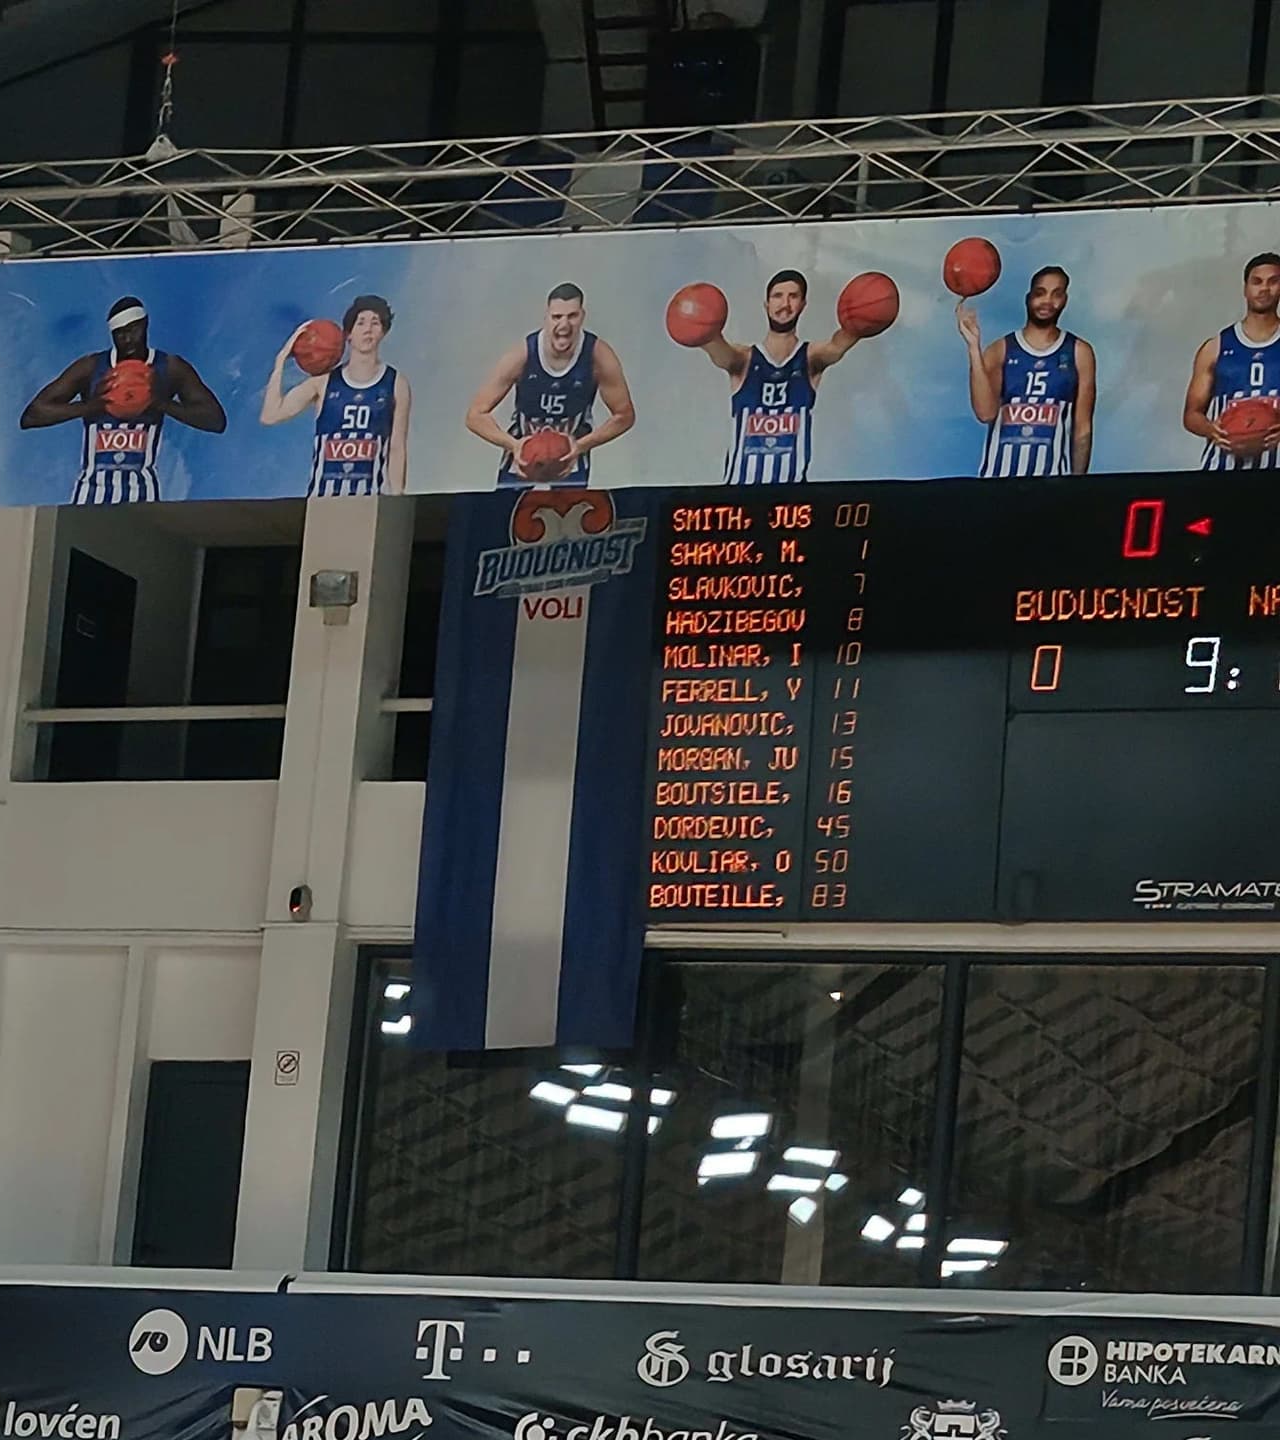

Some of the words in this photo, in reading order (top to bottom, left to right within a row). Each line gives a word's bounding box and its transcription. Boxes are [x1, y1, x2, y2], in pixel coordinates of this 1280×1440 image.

[1025, 370, 1050, 396] 15
[1250, 362, 1265, 387] 0
[539, 393, 566, 415] 45
[761, 382, 788, 406] 83
[341, 404, 370, 430] 50
[753, 414, 796, 435] VOLI
[1007, 405, 1056, 425] VOLI
[100, 430, 147, 450] VOLI
[328, 440, 373, 460] VOLI
[672, 507, 753, 532] SMITH,
[769, 503, 813, 529] JUS
[834, 503, 871, 528] 00
[1122, 499, 1167, 559] 0
[670, 541, 764, 566] SHAYOK,
[780, 540, 808, 564] M.
[860, 539, 869, 561] 1
[667, 573, 804, 601] SLAVKOVIC,
[853, 572, 867, 595] 7
[523, 596, 583, 620] VOLI
[1015, 586, 1206, 621] BUDUCNOST
[665, 608, 807, 635] HADZIBEGOV
[847, 607, 865, 631] 8
[663, 643, 771, 669] MOLINAR,
[836, 641, 862, 666] 10
[1029, 644, 1064, 692] 0
[661, 677, 770, 704] FERRELL,
[833, 677, 861, 701] 11
[659, 711, 795, 738] JOVANOVIC,
[831, 711, 859, 735] 13
[767, 746, 801, 771] JU
[829, 745, 856, 770] 15
[655, 780, 792, 806] BOUTSIELE,
[827, 779, 854, 805] 16
[653, 815, 776, 840] DORDEVIC,
[816, 814, 852, 839] 45
[814, 849, 850, 874] 50
[649, 883, 785, 909] BOUTEILLE,
[811, 883, 849, 908] 83
[195, 1325, 274, 1364] NLB
[706, 1343, 897, 1389] glosarij
[1103, 1362, 1188, 1386] BANKA
[3, 1401, 122, 1440] lovćen
